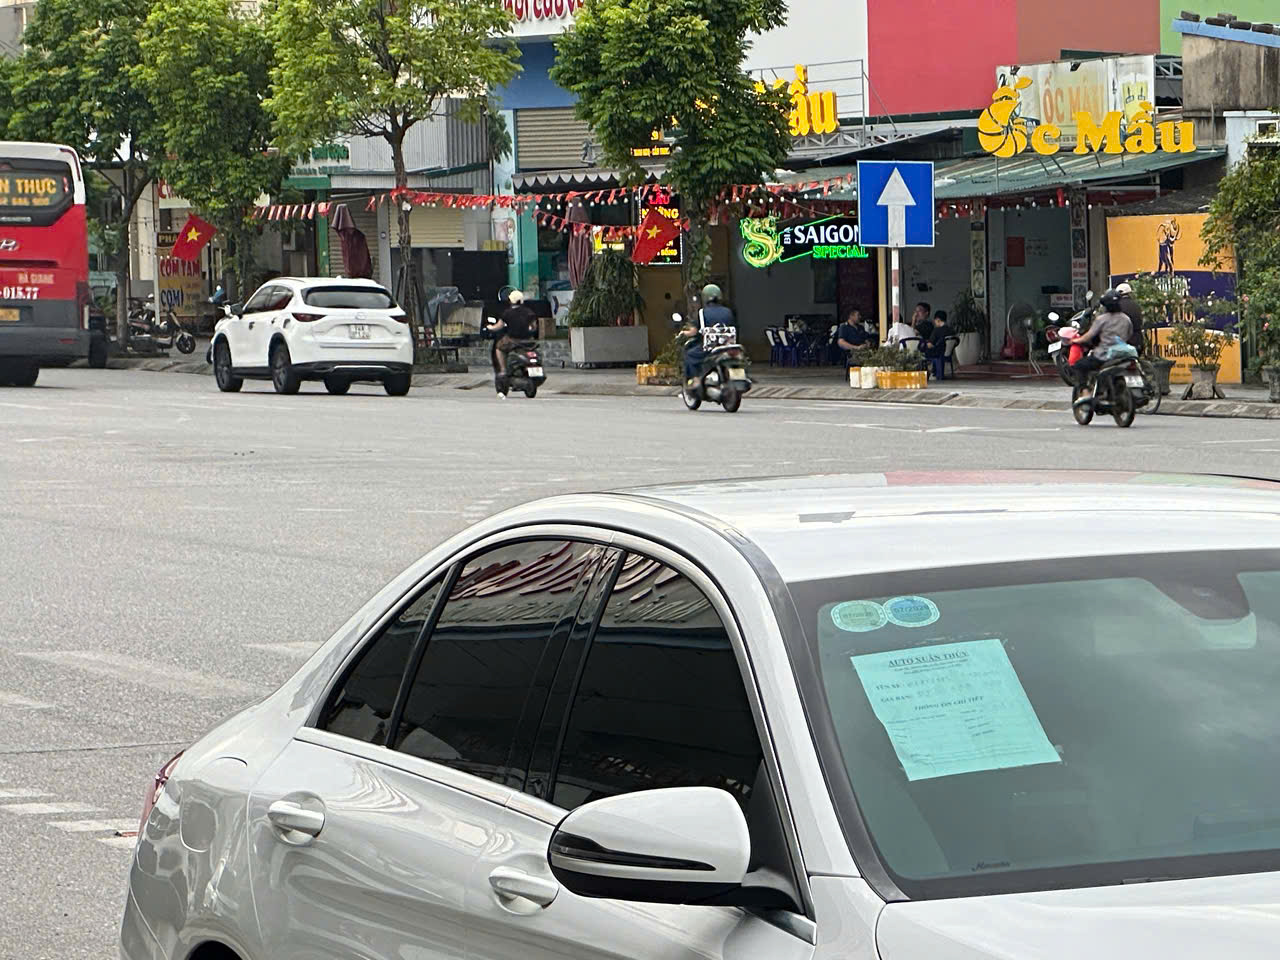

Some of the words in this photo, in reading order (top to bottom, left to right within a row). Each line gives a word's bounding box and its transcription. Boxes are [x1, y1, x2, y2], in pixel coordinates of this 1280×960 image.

[16, 177, 57, 197] THỰC
[784, 226, 792, 244] BIA
[812, 245, 869, 259] SPECIAL
